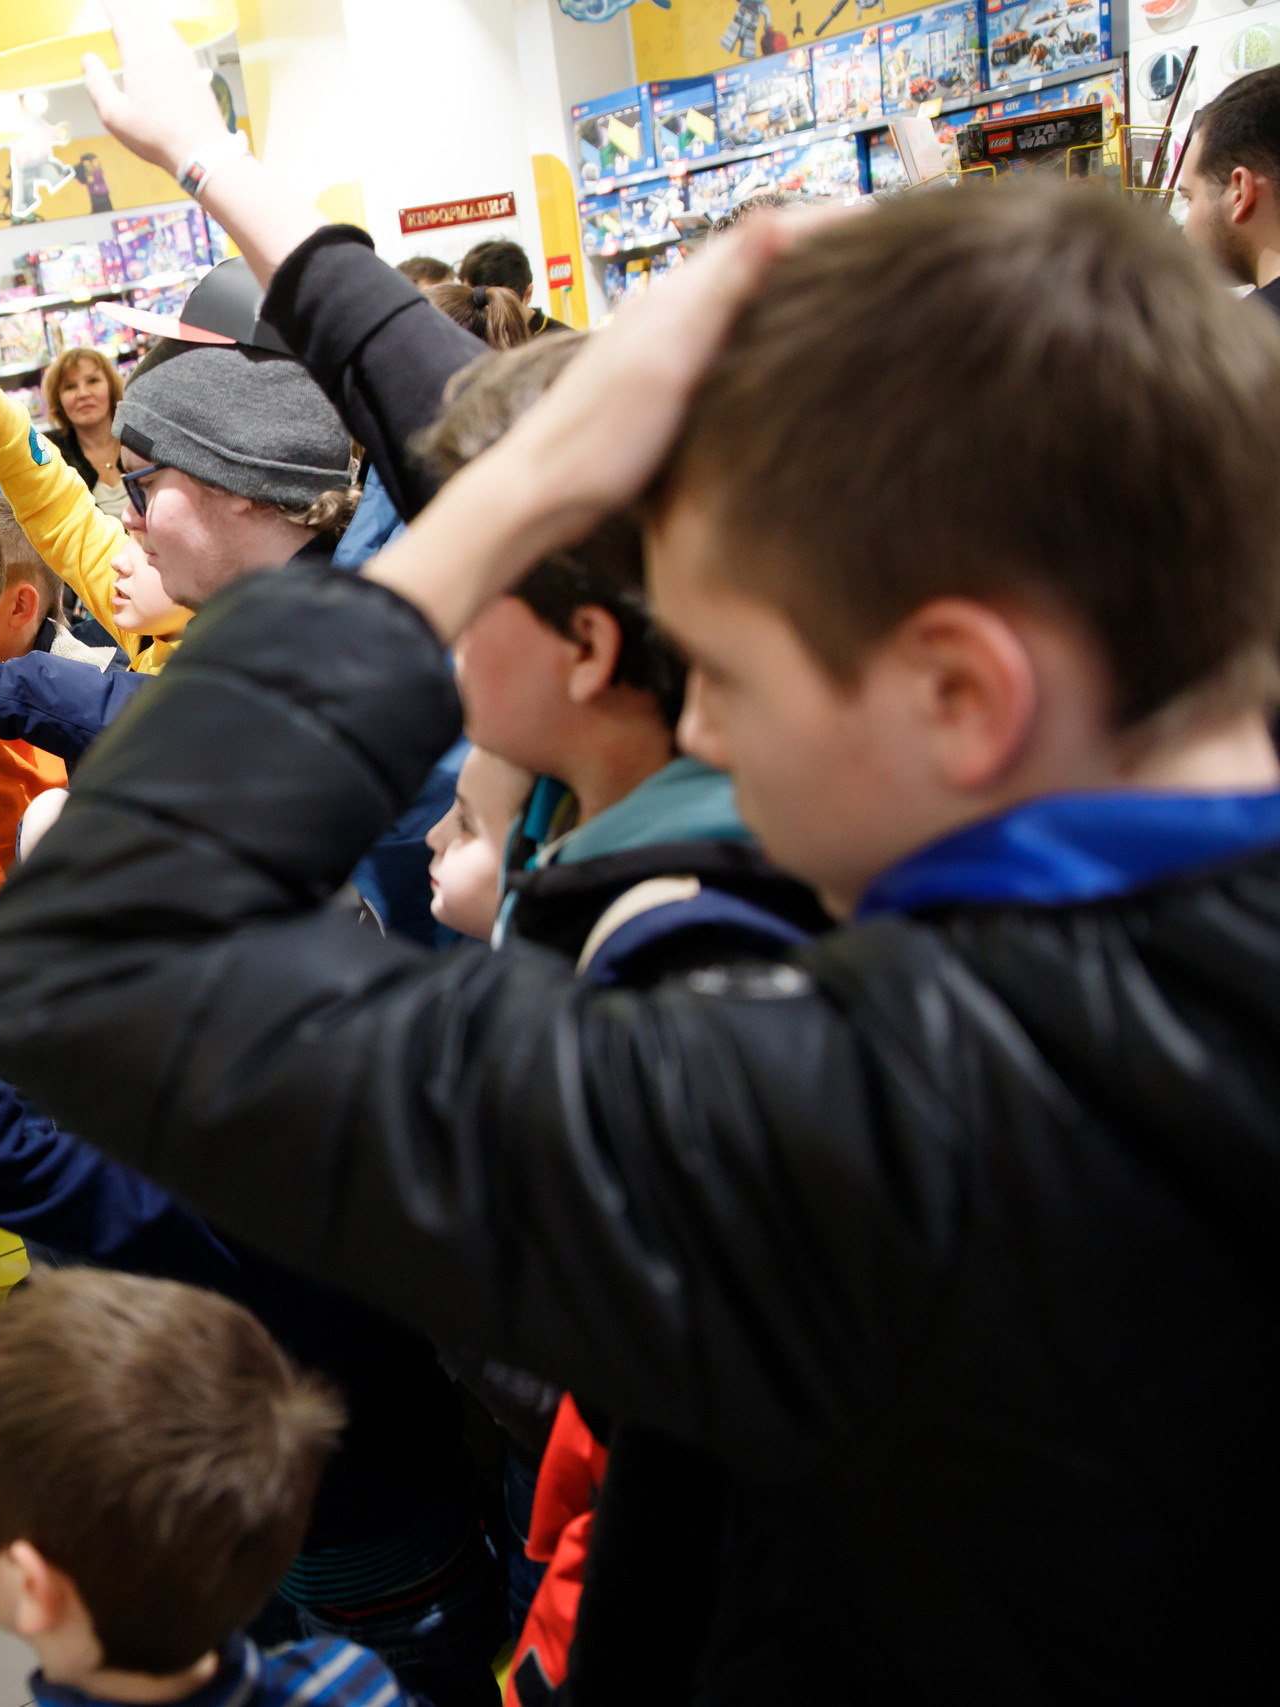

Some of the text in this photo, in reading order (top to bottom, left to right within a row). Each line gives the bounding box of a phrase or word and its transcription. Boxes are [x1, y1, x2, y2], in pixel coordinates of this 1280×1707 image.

[1024, 121, 1071, 138] STAR
[990, 137, 1011, 148] LEGO
[406, 198, 511, 228] ИНФОРМАЦИЯ
[549, 263, 571, 280] LEGO
